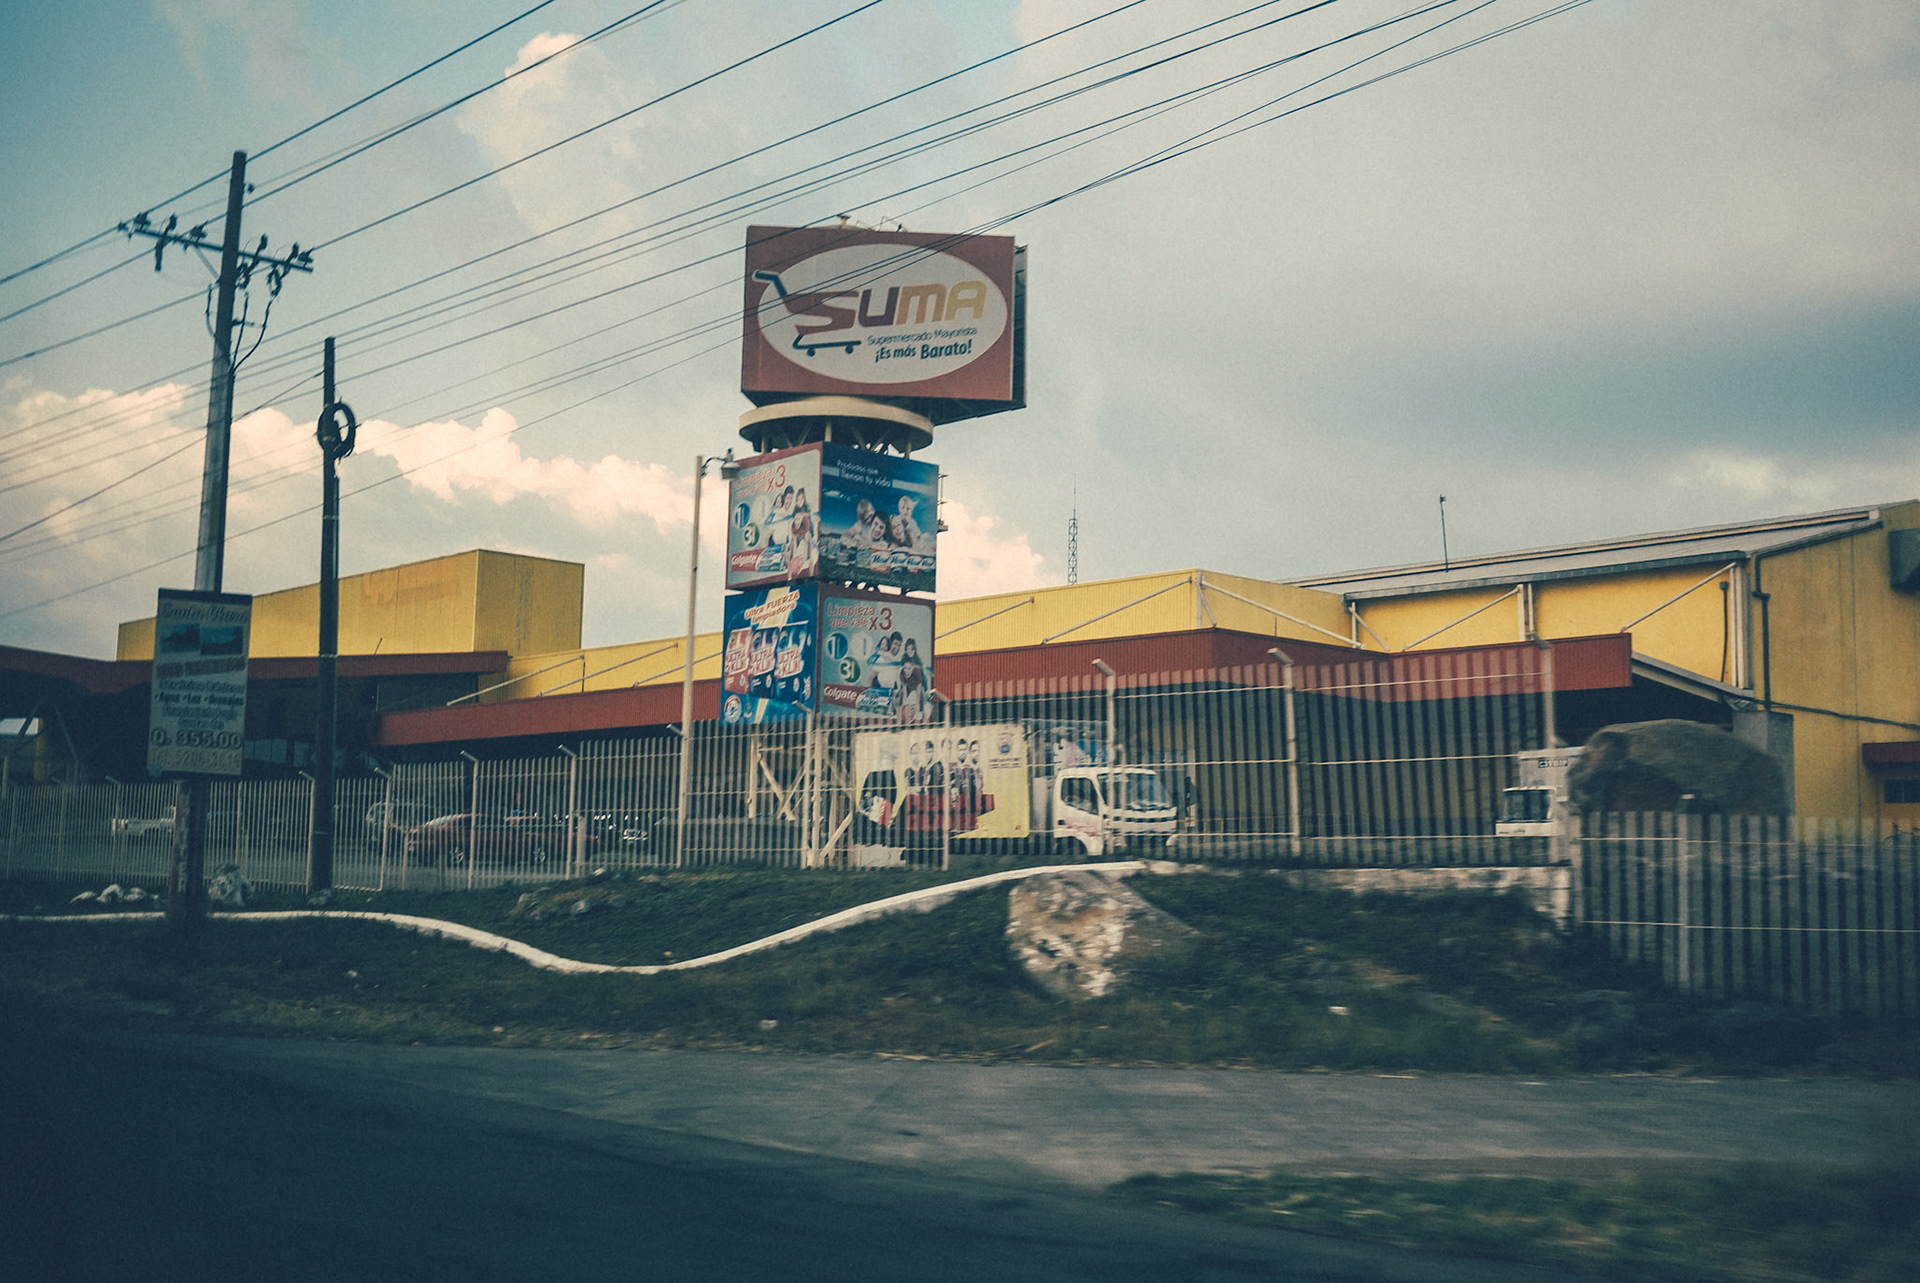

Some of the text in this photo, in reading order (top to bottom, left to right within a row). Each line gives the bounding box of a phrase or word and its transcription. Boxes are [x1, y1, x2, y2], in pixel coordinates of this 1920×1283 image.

[784, 280, 988, 336] SUMA
[866, 326, 979, 346] Supermercado Mayorista
[874, 338, 973, 364] ¡Es más Barato!
[731, 553, 758, 568] Colgate
[766, 591, 799, 609] FUERZA
[827, 603, 875, 618] Limpieza
[823, 685, 858, 701] Colgate
